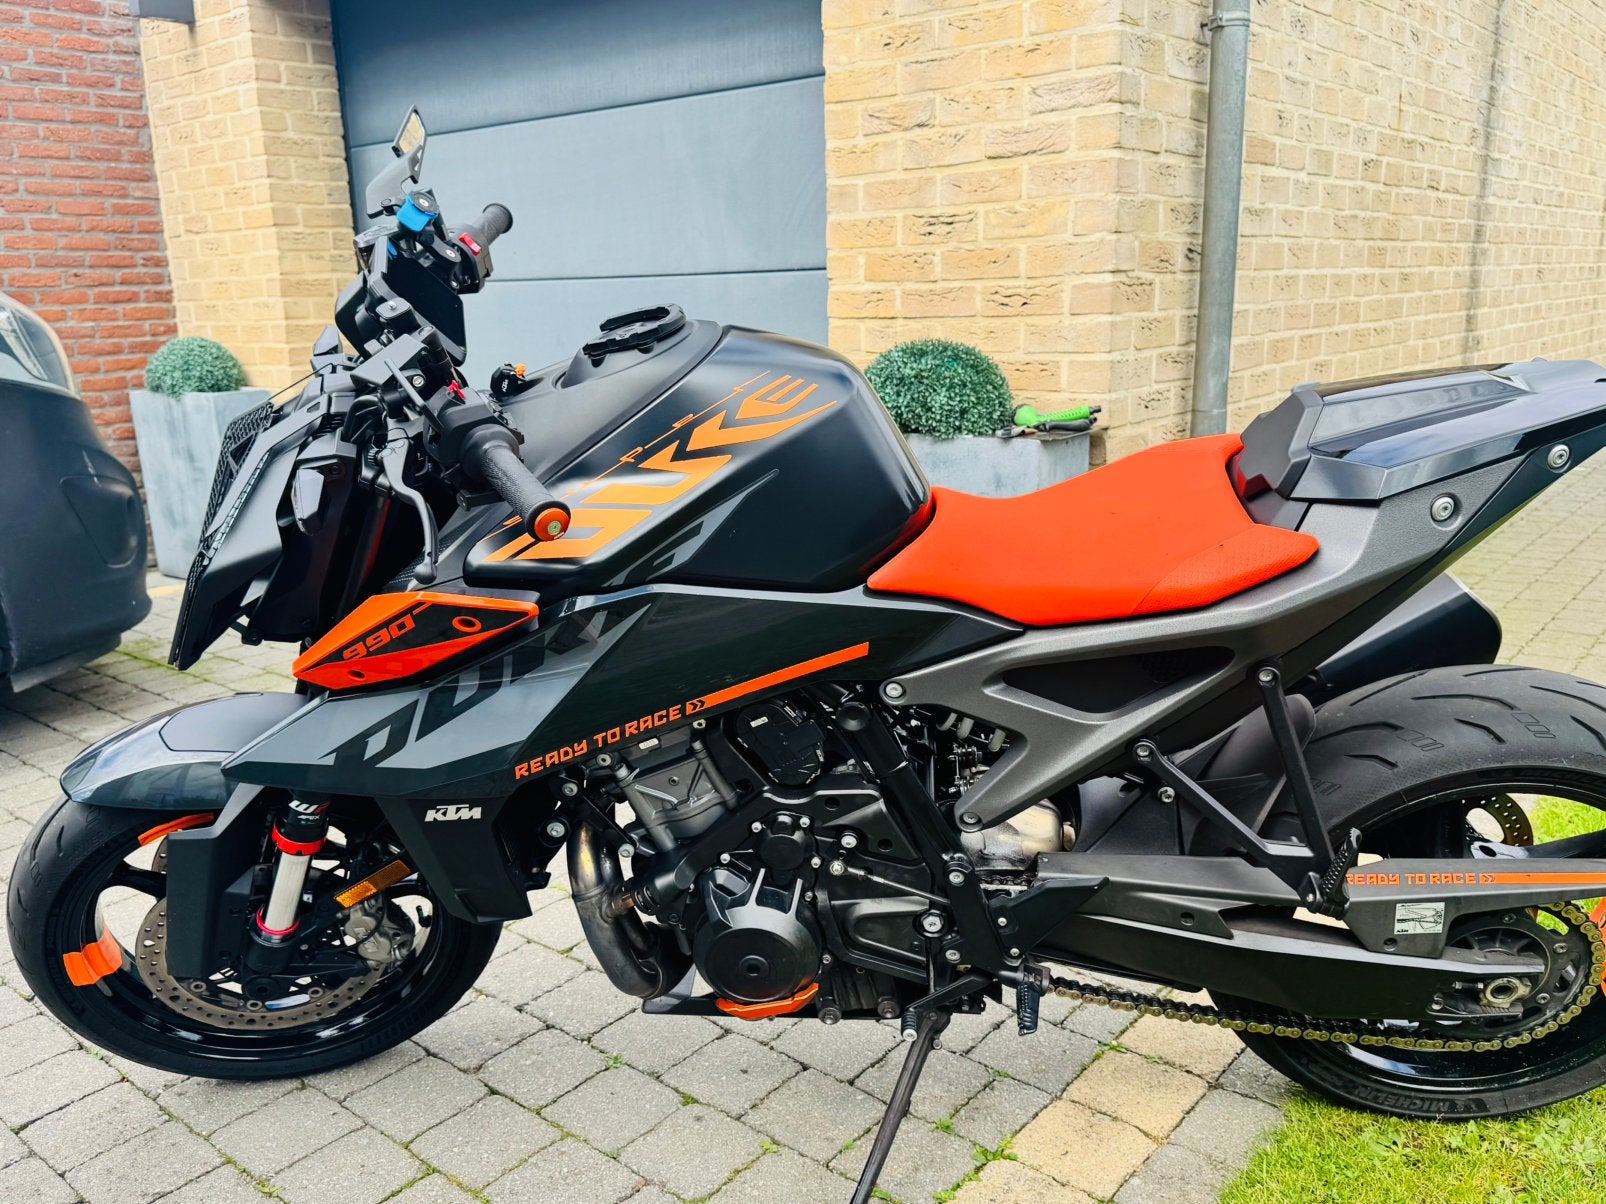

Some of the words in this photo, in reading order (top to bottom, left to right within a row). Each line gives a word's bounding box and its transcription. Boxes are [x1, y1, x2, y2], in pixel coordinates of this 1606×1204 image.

[483, 375, 838, 562] DUKE
[342, 613, 416, 661] 990
[514, 740, 588, 780] READY
[594, 727, 621, 748] TO
[625, 704, 682, 737] RACE
[424, 804, 482, 822] KTM
[1405, 873, 1426, 885] TO
[1429, 873, 1476, 885] RACE
[1354, 1085, 1449, 1112] MICHELIN
